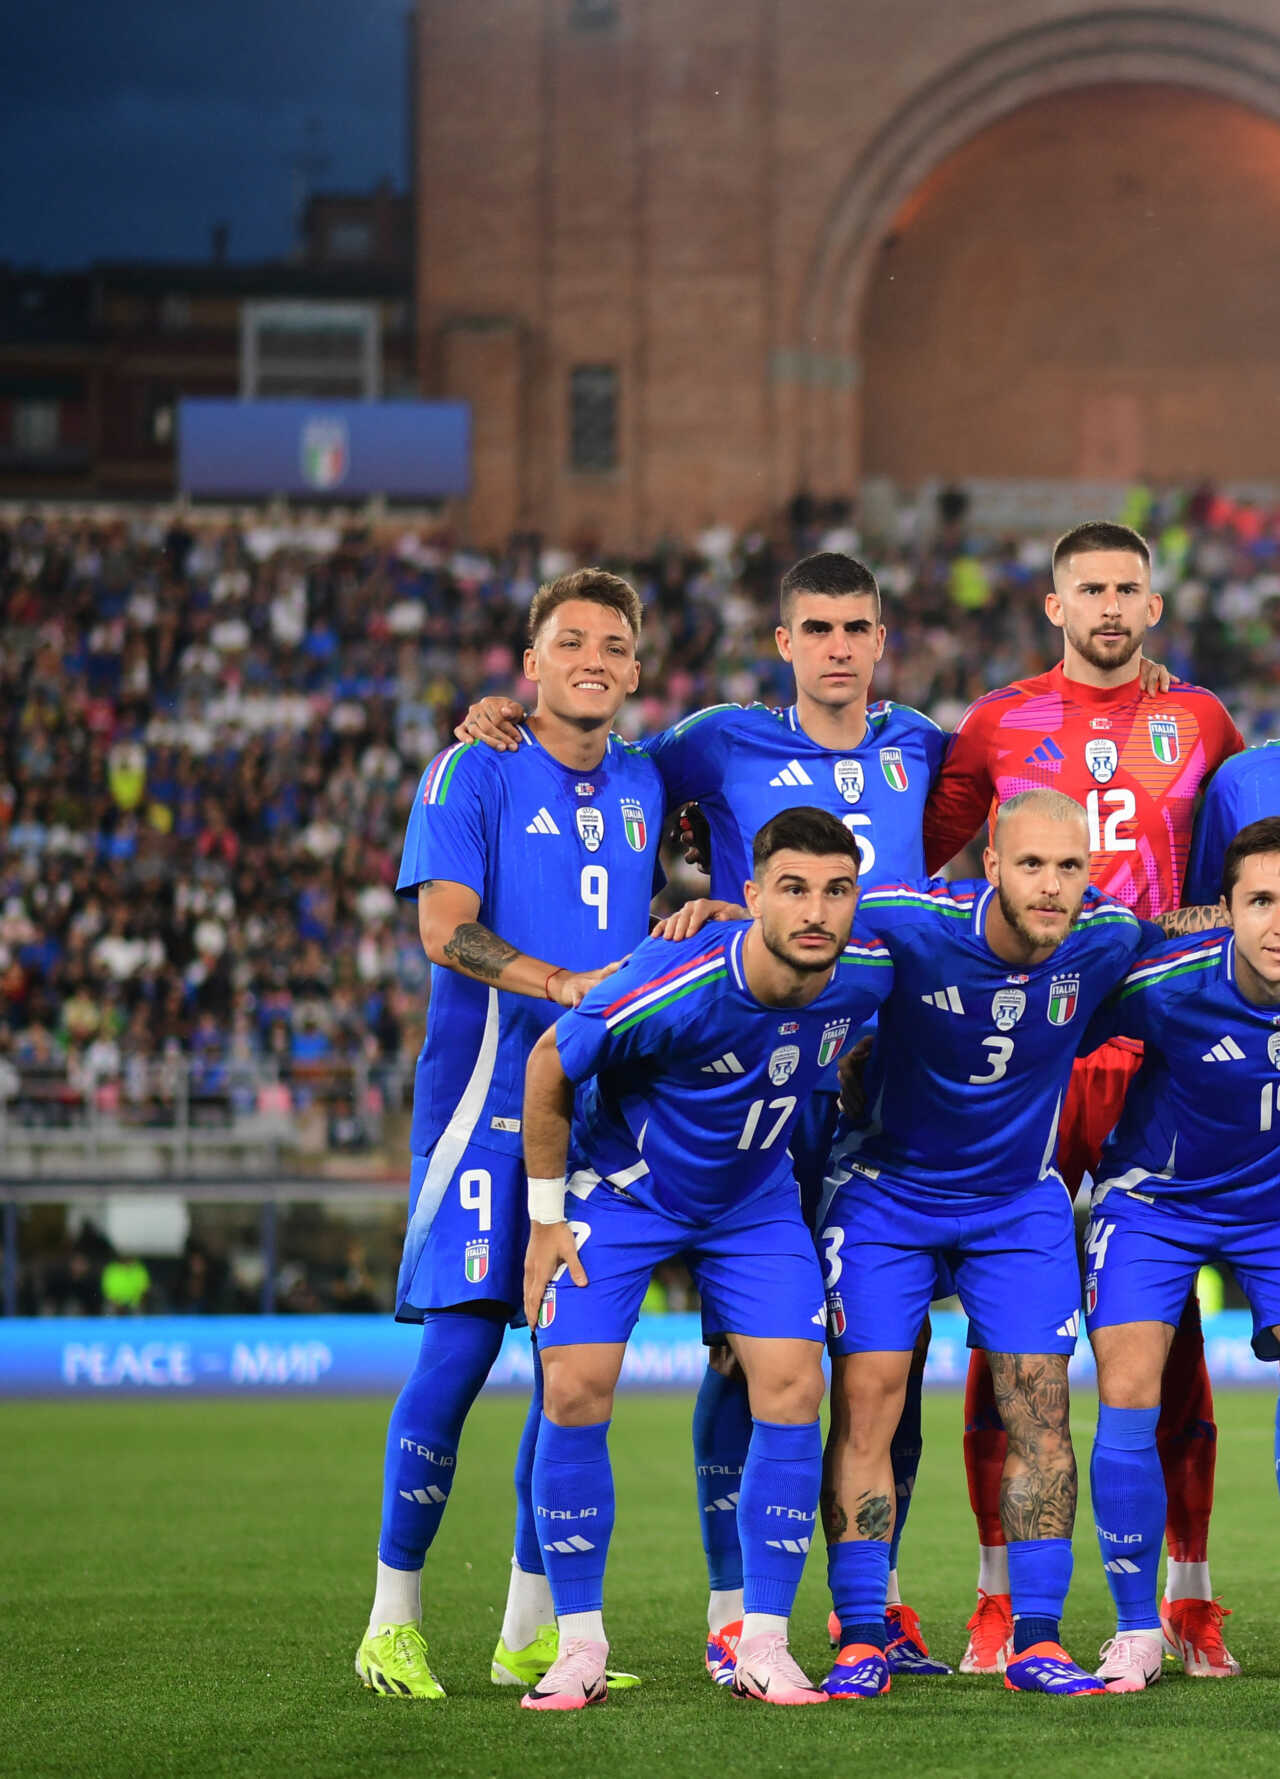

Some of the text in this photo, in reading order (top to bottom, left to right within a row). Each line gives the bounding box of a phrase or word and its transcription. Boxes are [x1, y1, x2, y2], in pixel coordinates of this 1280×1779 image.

[1086, 788, 1136, 852] 12
[580, 864, 609, 930] 9
[1052, 983, 1076, 995] ITALIA
[823, 1027, 846, 1041] ITALIA
[968, 1035, 1015, 1084] 3
[737, 1095, 797, 1151] 17
[459, 1169, 492, 1231] 9
[822, 1226, 845, 1290] 3
[62, 1341, 194, 1386] PEACE
[400, 1437, 454, 1467] ITALIA
[537, 1505, 598, 1520] ITALIA
